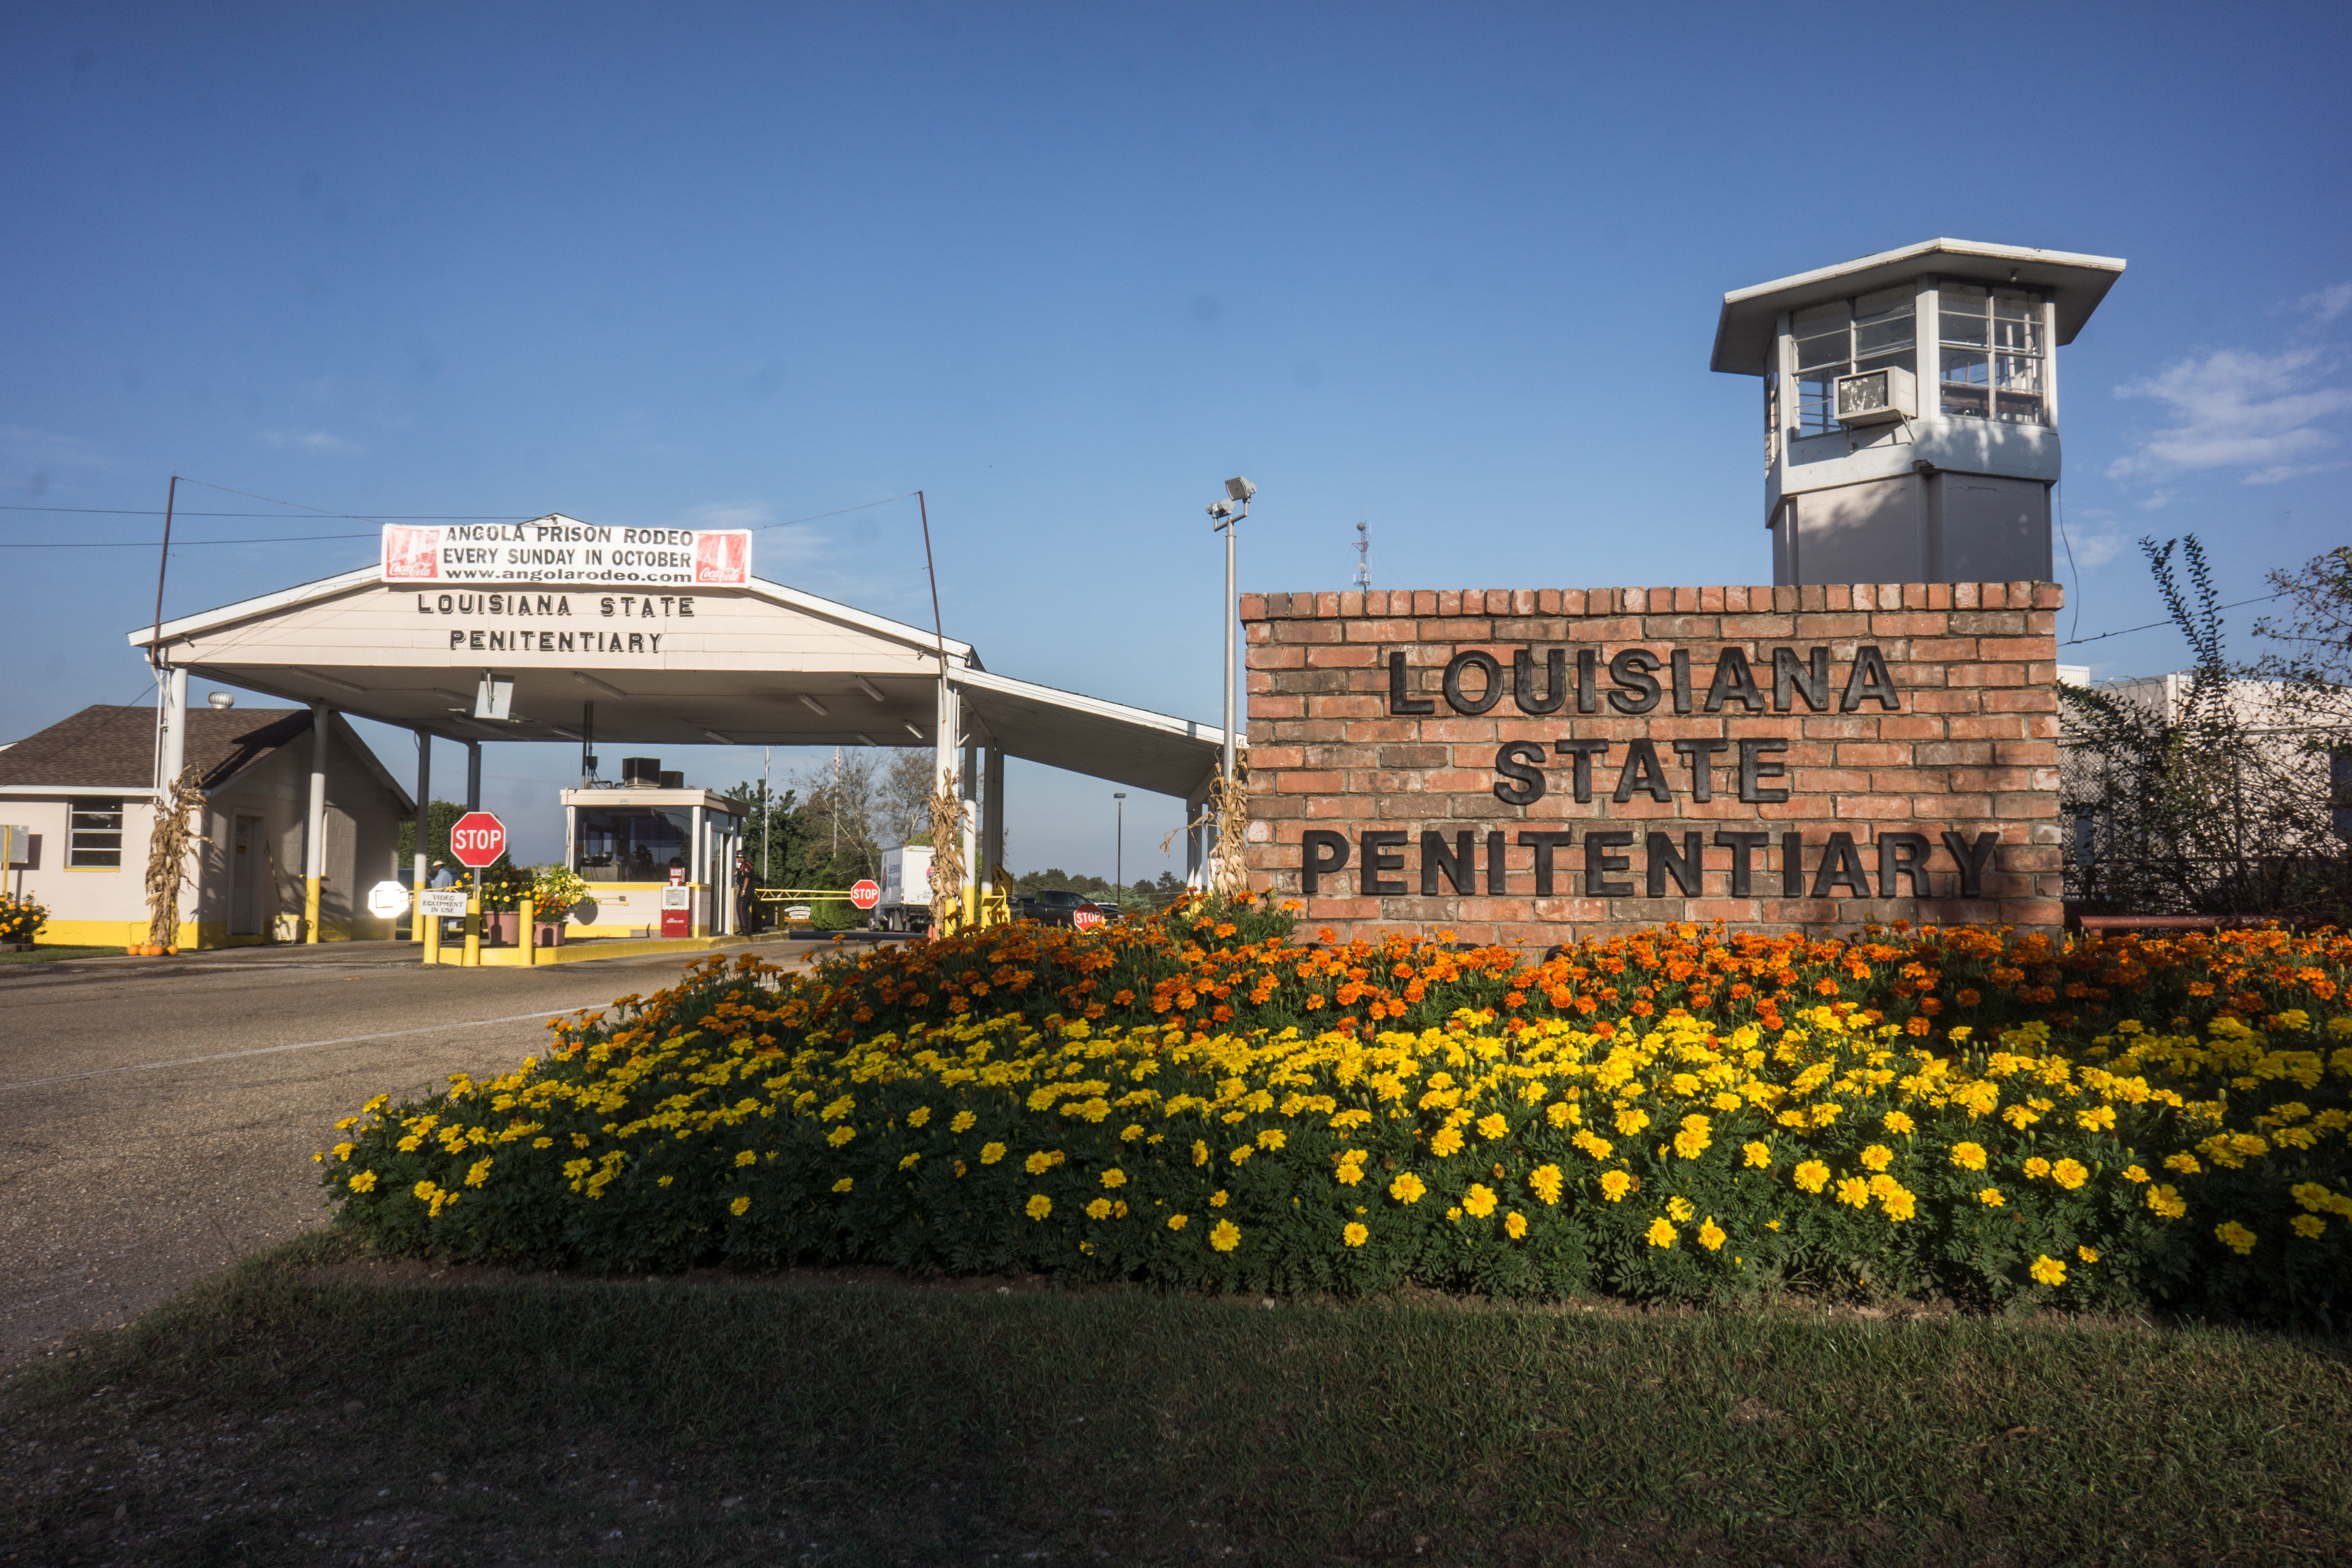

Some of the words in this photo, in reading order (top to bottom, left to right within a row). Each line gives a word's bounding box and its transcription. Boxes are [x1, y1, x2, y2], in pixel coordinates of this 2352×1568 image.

[446, 525, 525, 542] ANGOLA
[537, 526, 612, 543] PRISON
[624, 529, 693, 546] RODEO
[443, 548, 498, 564] EVERY
[508, 548, 575, 565] SUNDAY
[586, 550, 602, 565] IN
[612, 550, 691, 568] OCTOBER
[445, 568, 692, 583] www.angolarodeo.com
[418, 594, 572, 616] LOUISIANA
[600, 597, 695, 618] STATE
[450, 630, 662, 653] PENITENTIARY
[1389, 645, 1901, 716] LOUISIANA
[1494, 737, 1789, 806] STATE
[455, 829, 501, 849] STOP
[1301, 829, 2000, 898] PENITENTIARY
[853, 888, 878, 900] STOP
[1076, 911, 1101, 924] STOP
